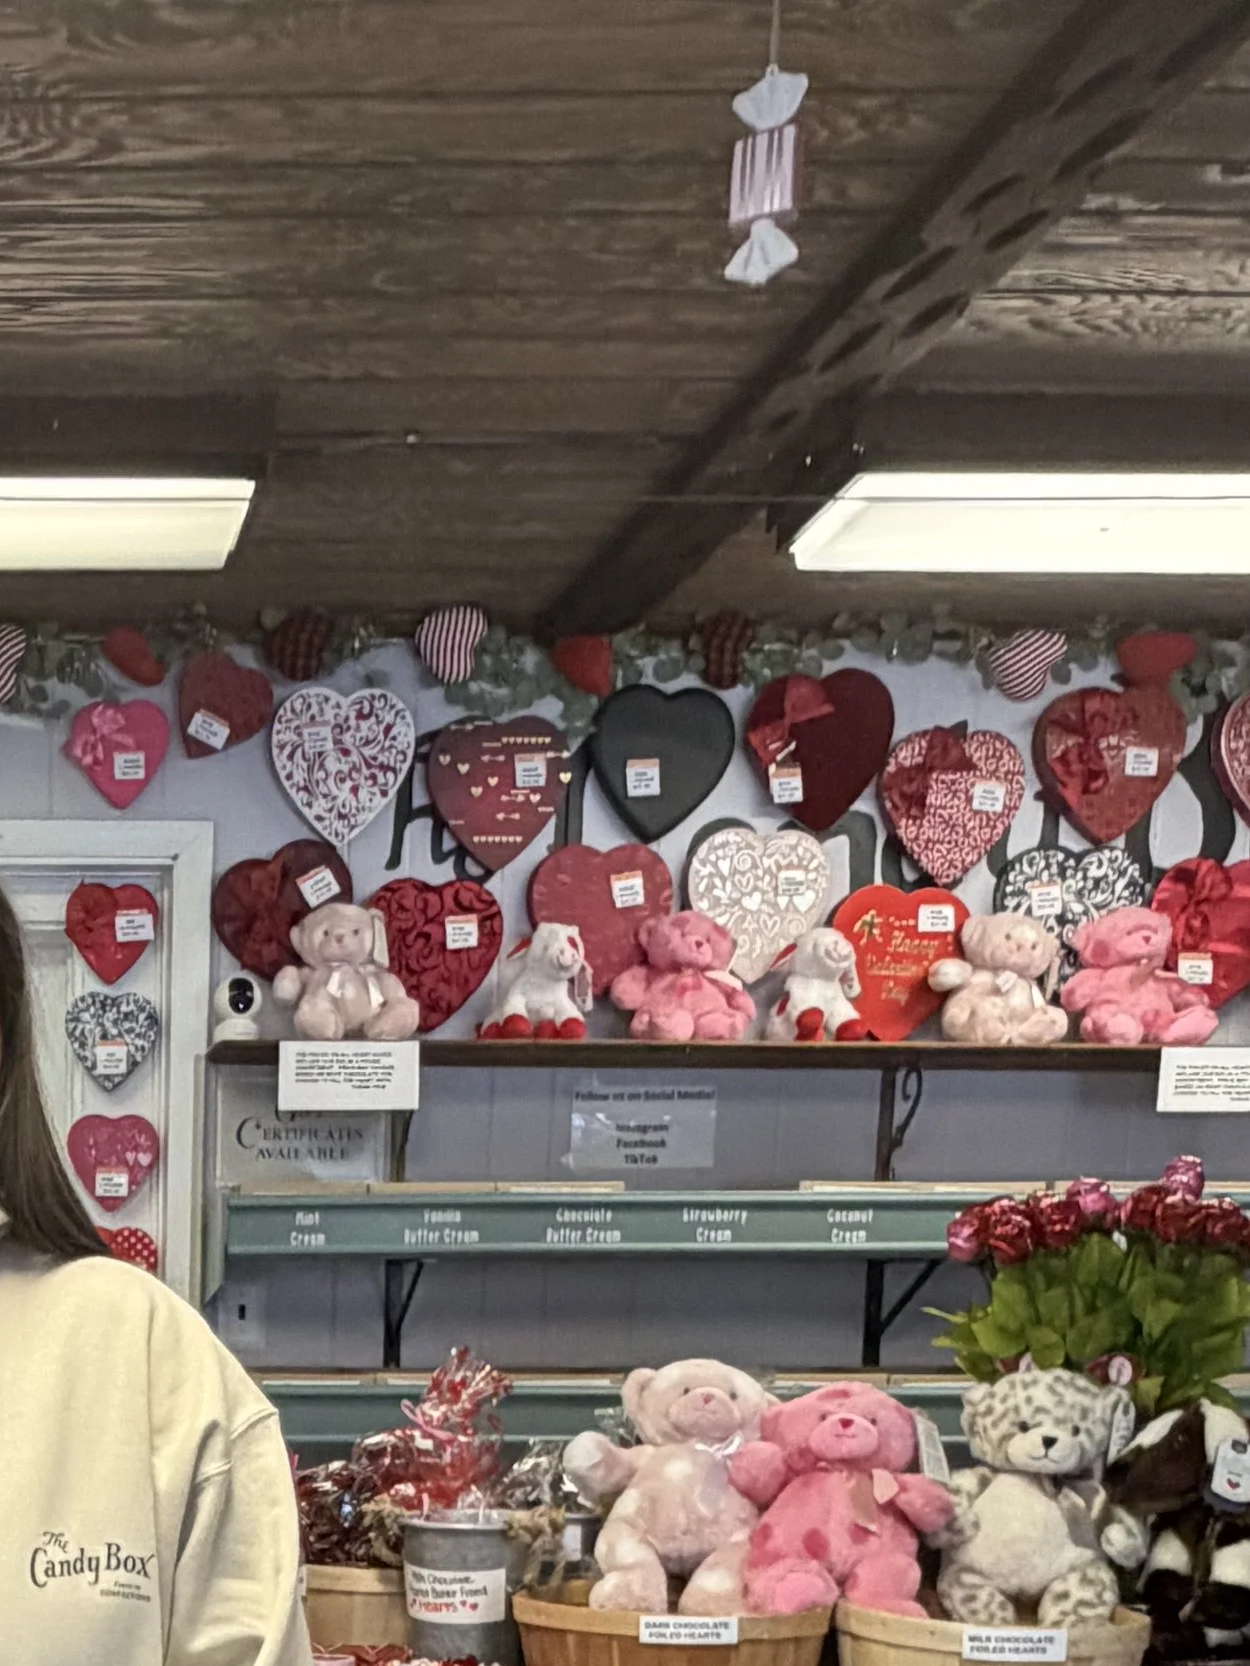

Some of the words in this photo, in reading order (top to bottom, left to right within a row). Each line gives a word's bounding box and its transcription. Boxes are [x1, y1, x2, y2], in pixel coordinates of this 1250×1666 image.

[42, 1531, 69, 1554] The
[30, 1547, 101, 1588] Candy
[105, 1542, 156, 1580] Box
